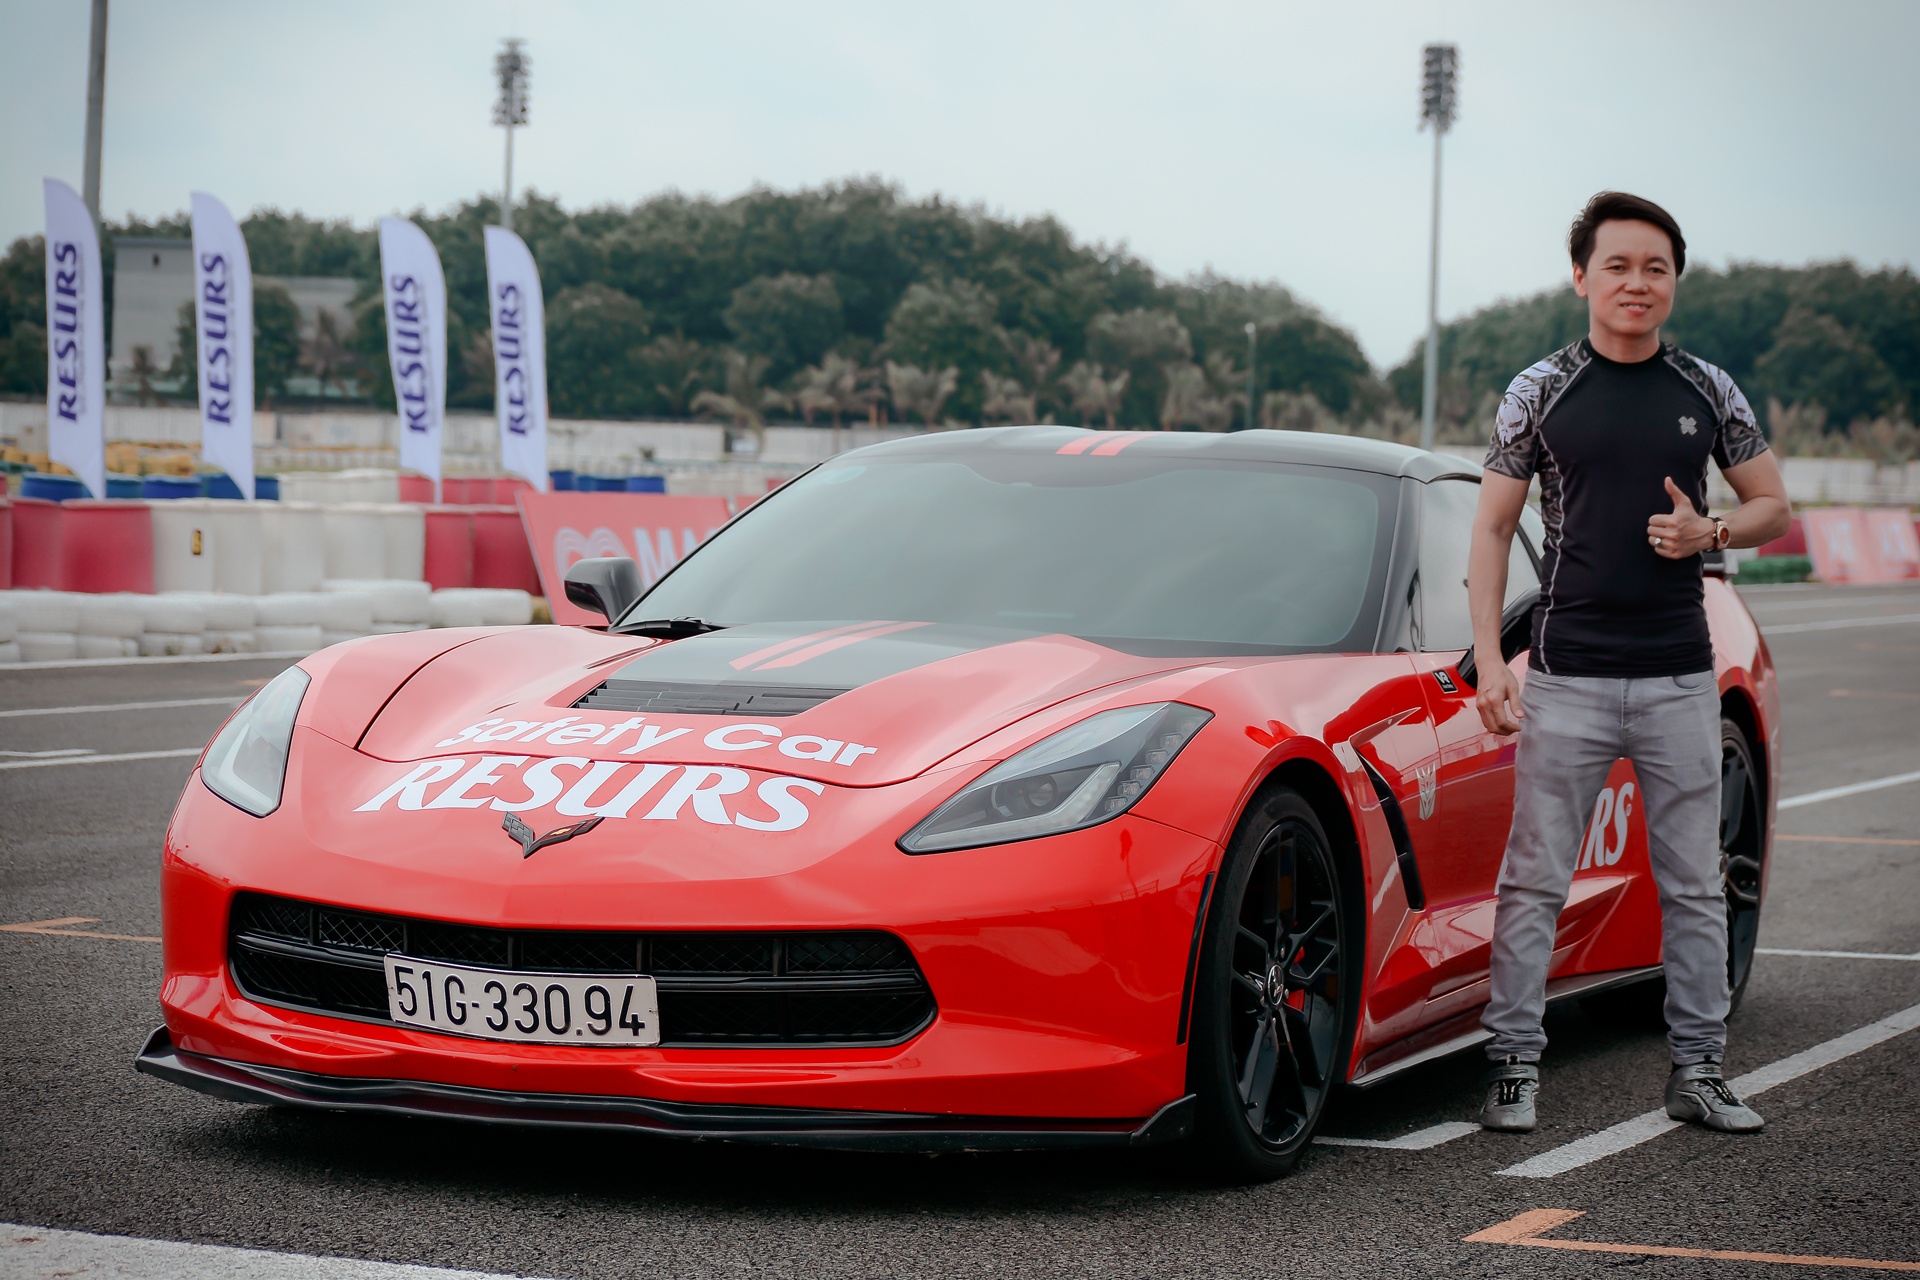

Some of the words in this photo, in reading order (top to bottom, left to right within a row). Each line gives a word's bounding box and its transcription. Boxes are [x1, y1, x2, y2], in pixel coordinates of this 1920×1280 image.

[54, 241, 77, 421] RESURS
[202, 254, 230, 424] RESURS
[392, 276, 426, 432] RESURS
[499, 284, 526, 434] RESURS
[352, 756, 825, 831] RESURS
[435, 716, 694, 754] Safety
[703, 723, 878, 766] Car
[395, 966, 646, 1036] 51G-330.94
